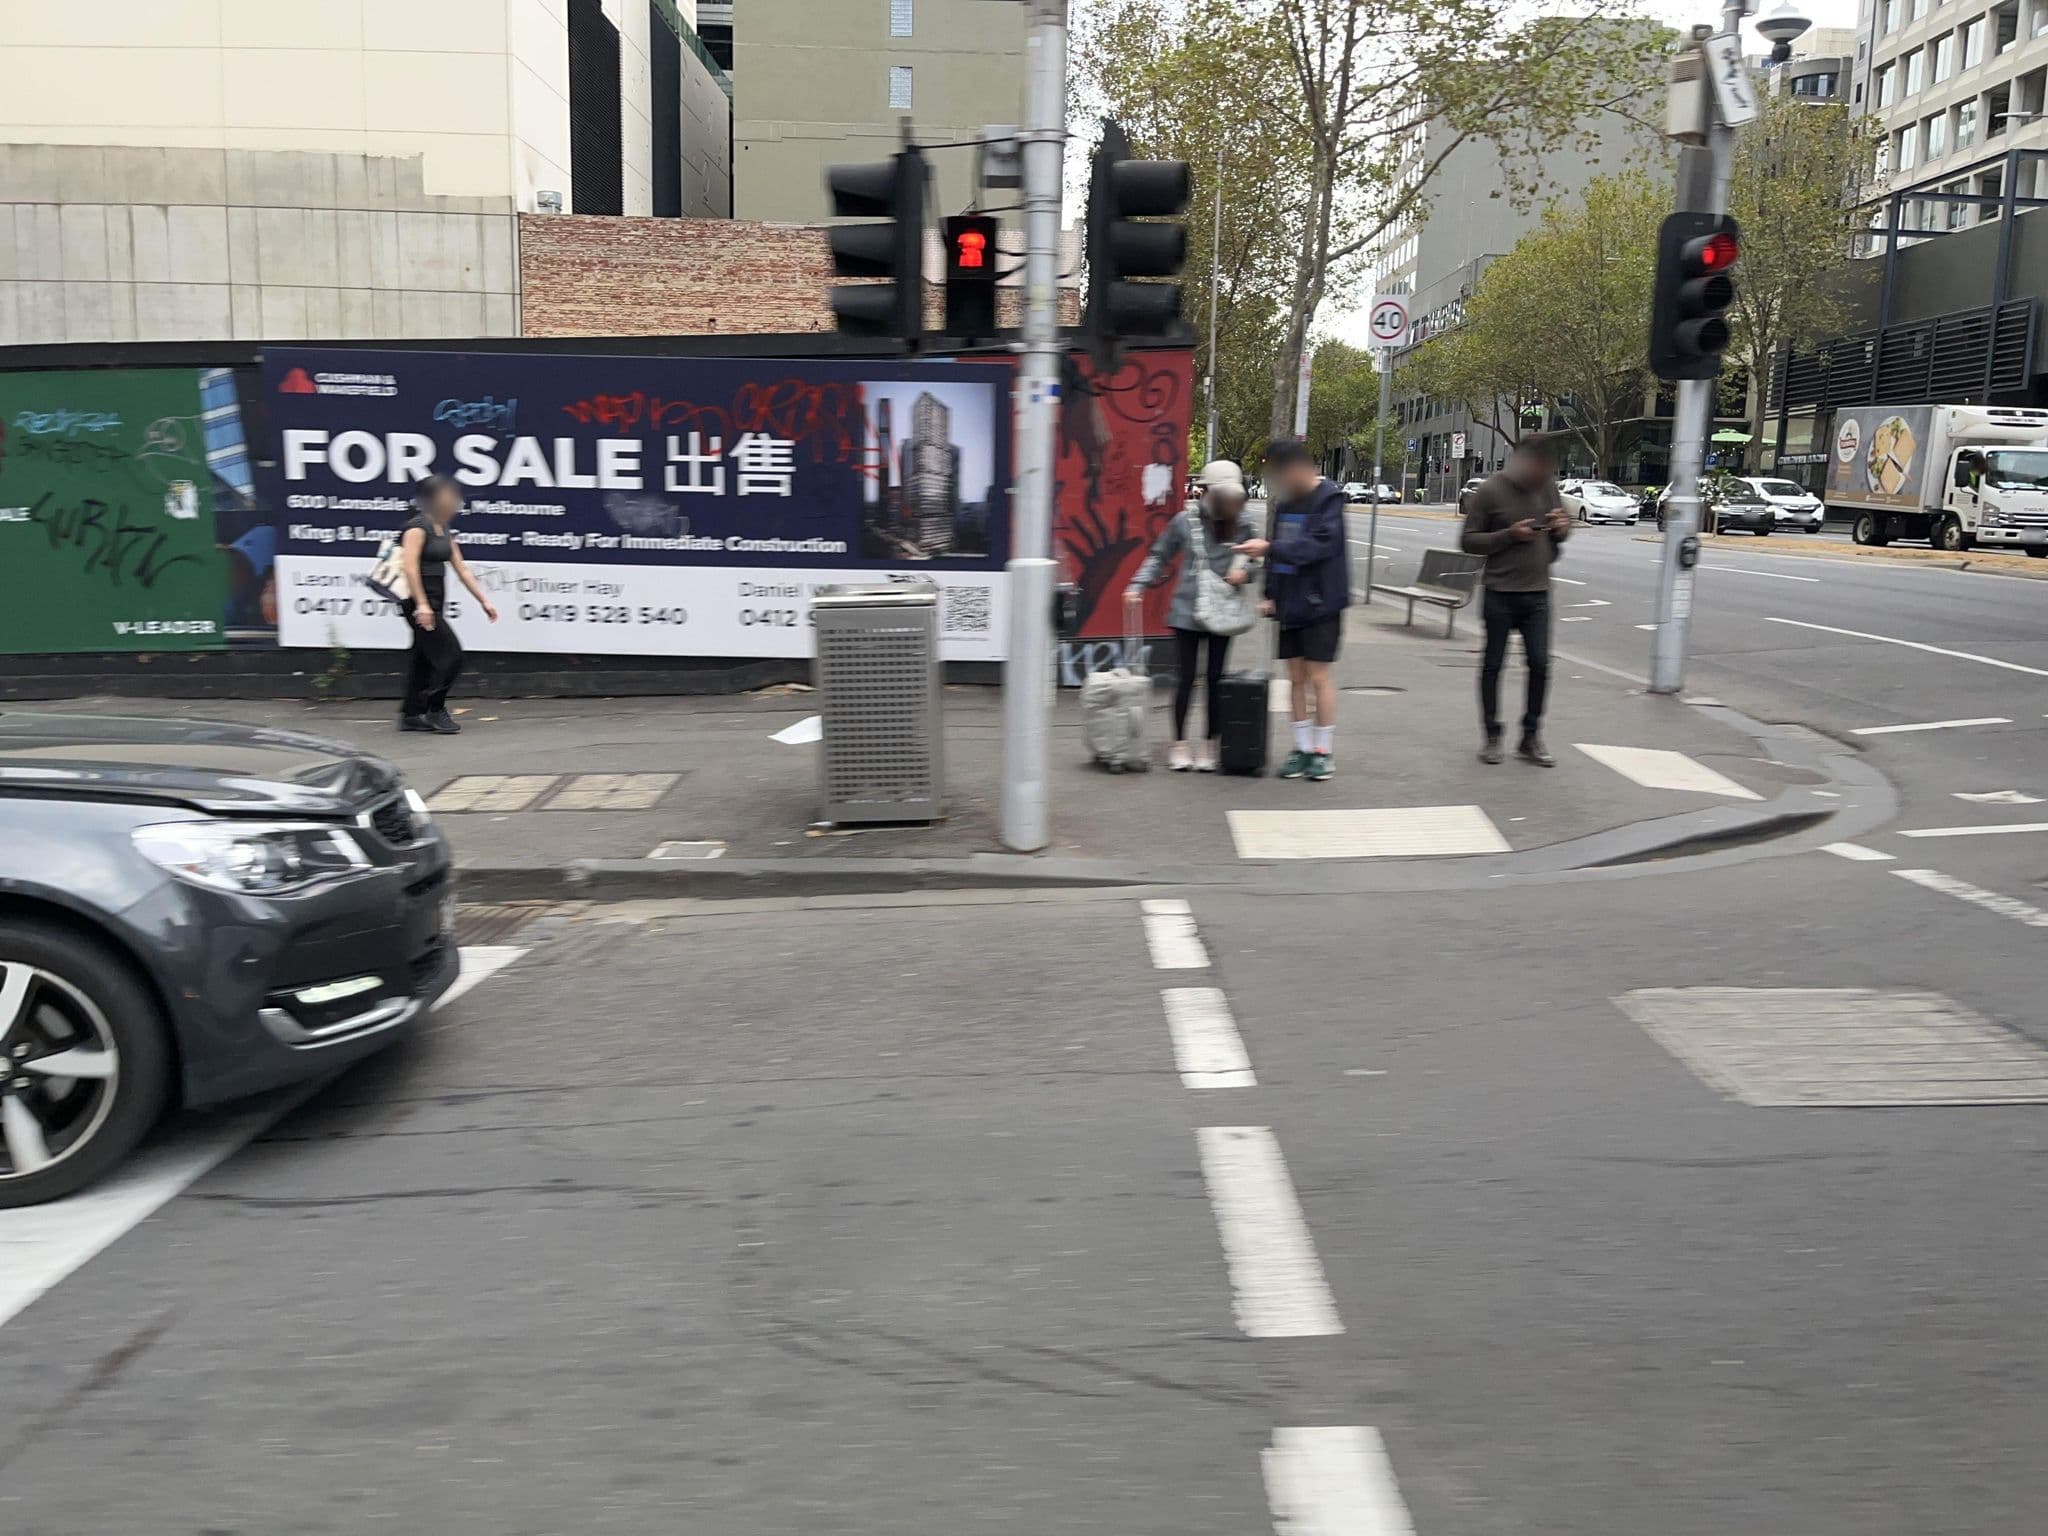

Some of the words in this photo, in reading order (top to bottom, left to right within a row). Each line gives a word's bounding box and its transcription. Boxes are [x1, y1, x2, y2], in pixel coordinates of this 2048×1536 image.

[1374, 311, 1402, 330] 40
[282, 429, 436, 483] FOR
[453, 434, 643, 489] SALE
[664, 431, 796, 497] 出售
[328, 496, 408, 511] Lonsdale
[471, 500, 566, 516] Melbourne
[288, 524, 336, 543] King
[337, 526, 355, 541] &
[522, 531, 584, 550] Ready
[585, 533, 620, 548] For
[621, 534, 723, 551] Immediate
[724, 536, 848, 553] Construction
[739, 581, 804, 597] Daniel
[294, 597, 353, 616] 0417
[518, 603, 579, 622] 0419
[638, 606, 689, 626] 540
[740, 608, 798, 627] 0412
